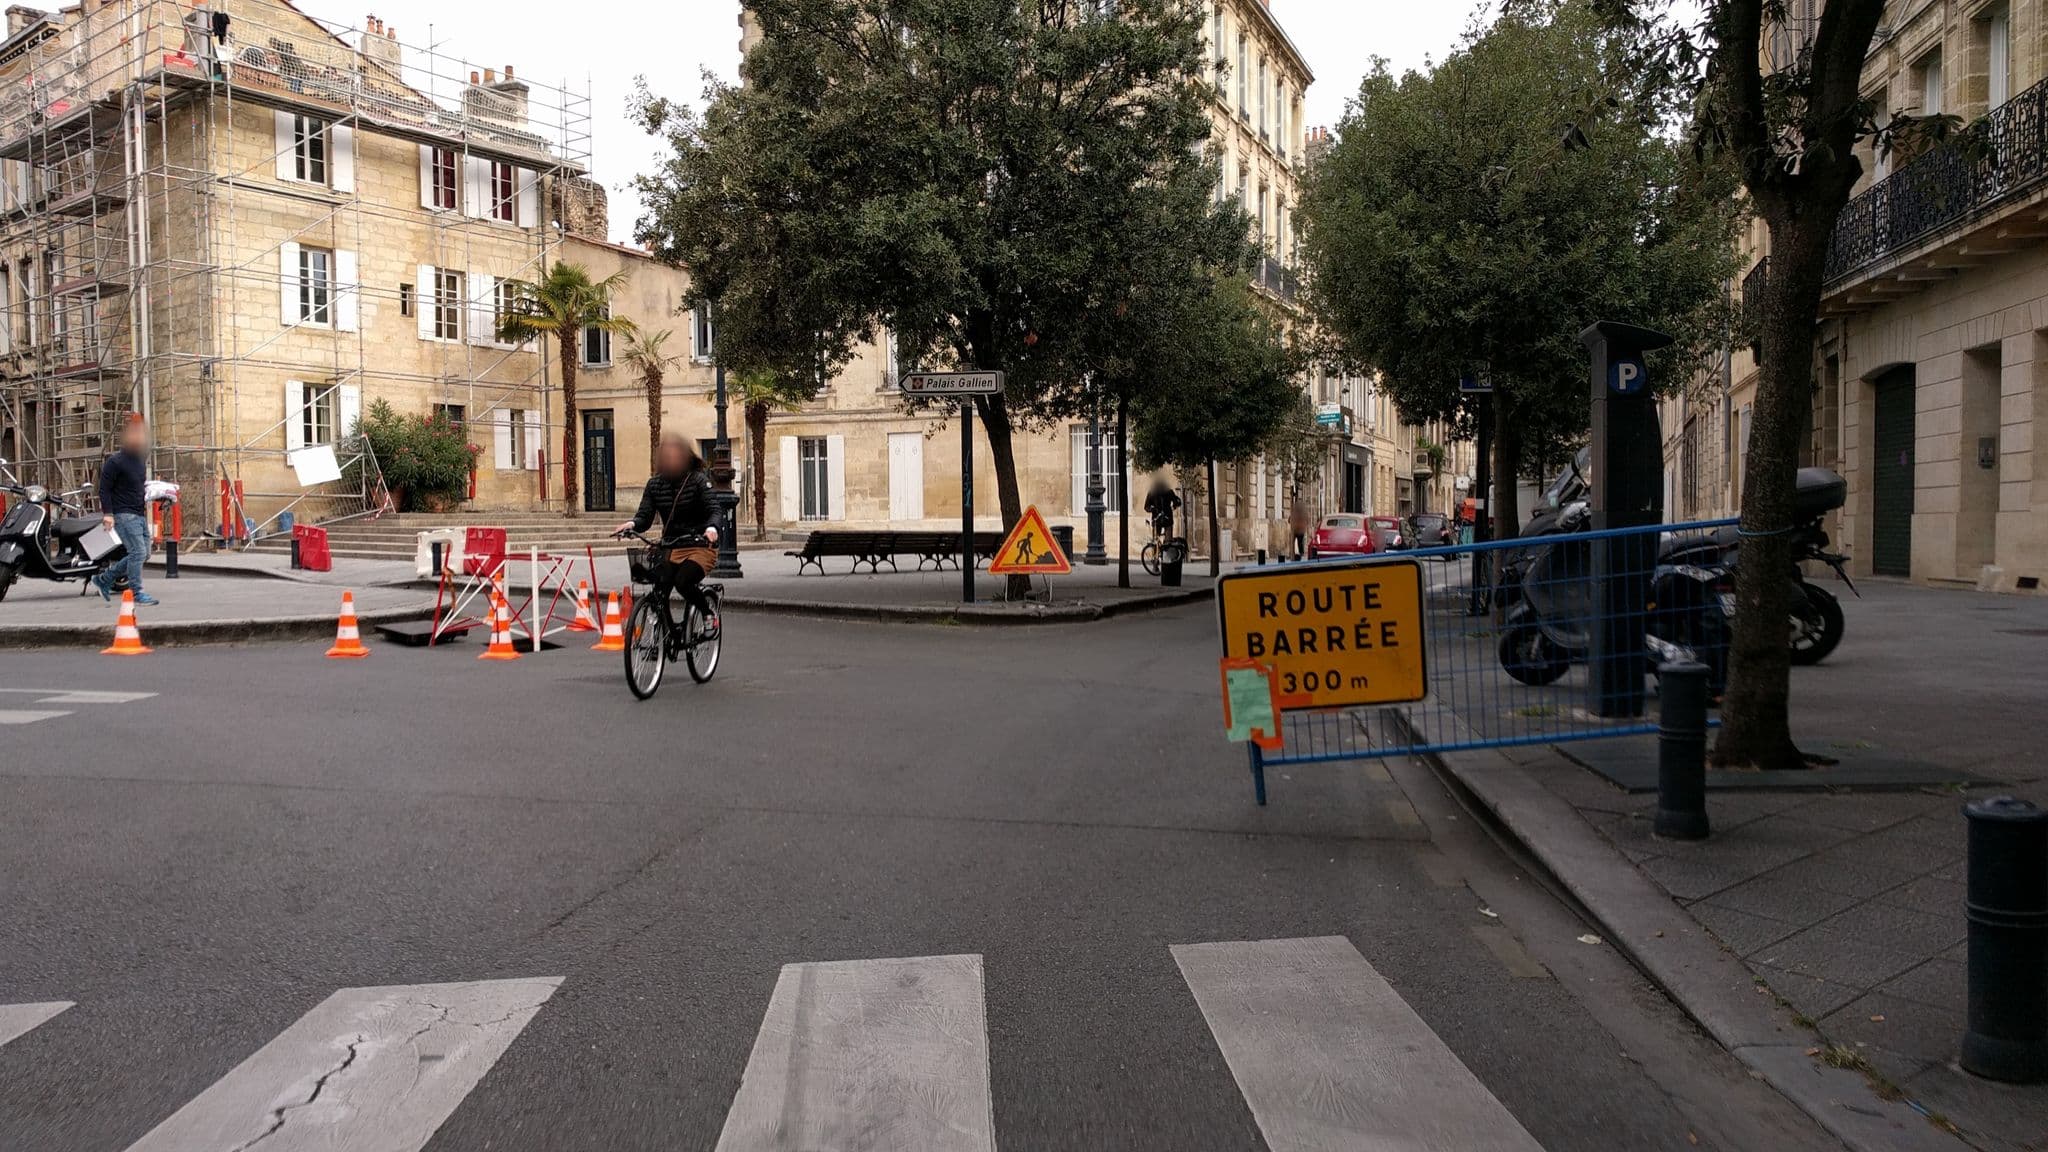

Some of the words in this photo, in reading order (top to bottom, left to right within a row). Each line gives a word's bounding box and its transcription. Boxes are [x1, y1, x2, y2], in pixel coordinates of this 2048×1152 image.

[926, 378, 955, 389] Palais
[958, 377, 993, 388] Gallien
[1618, 363, 1638, 390] P
[1258, 583, 1381, 618] ROUTE
[1246, 617, 1399, 658] BARRÉE
[1283, 670, 1341, 694] 300
[1351, 675, 1369, 690] m
